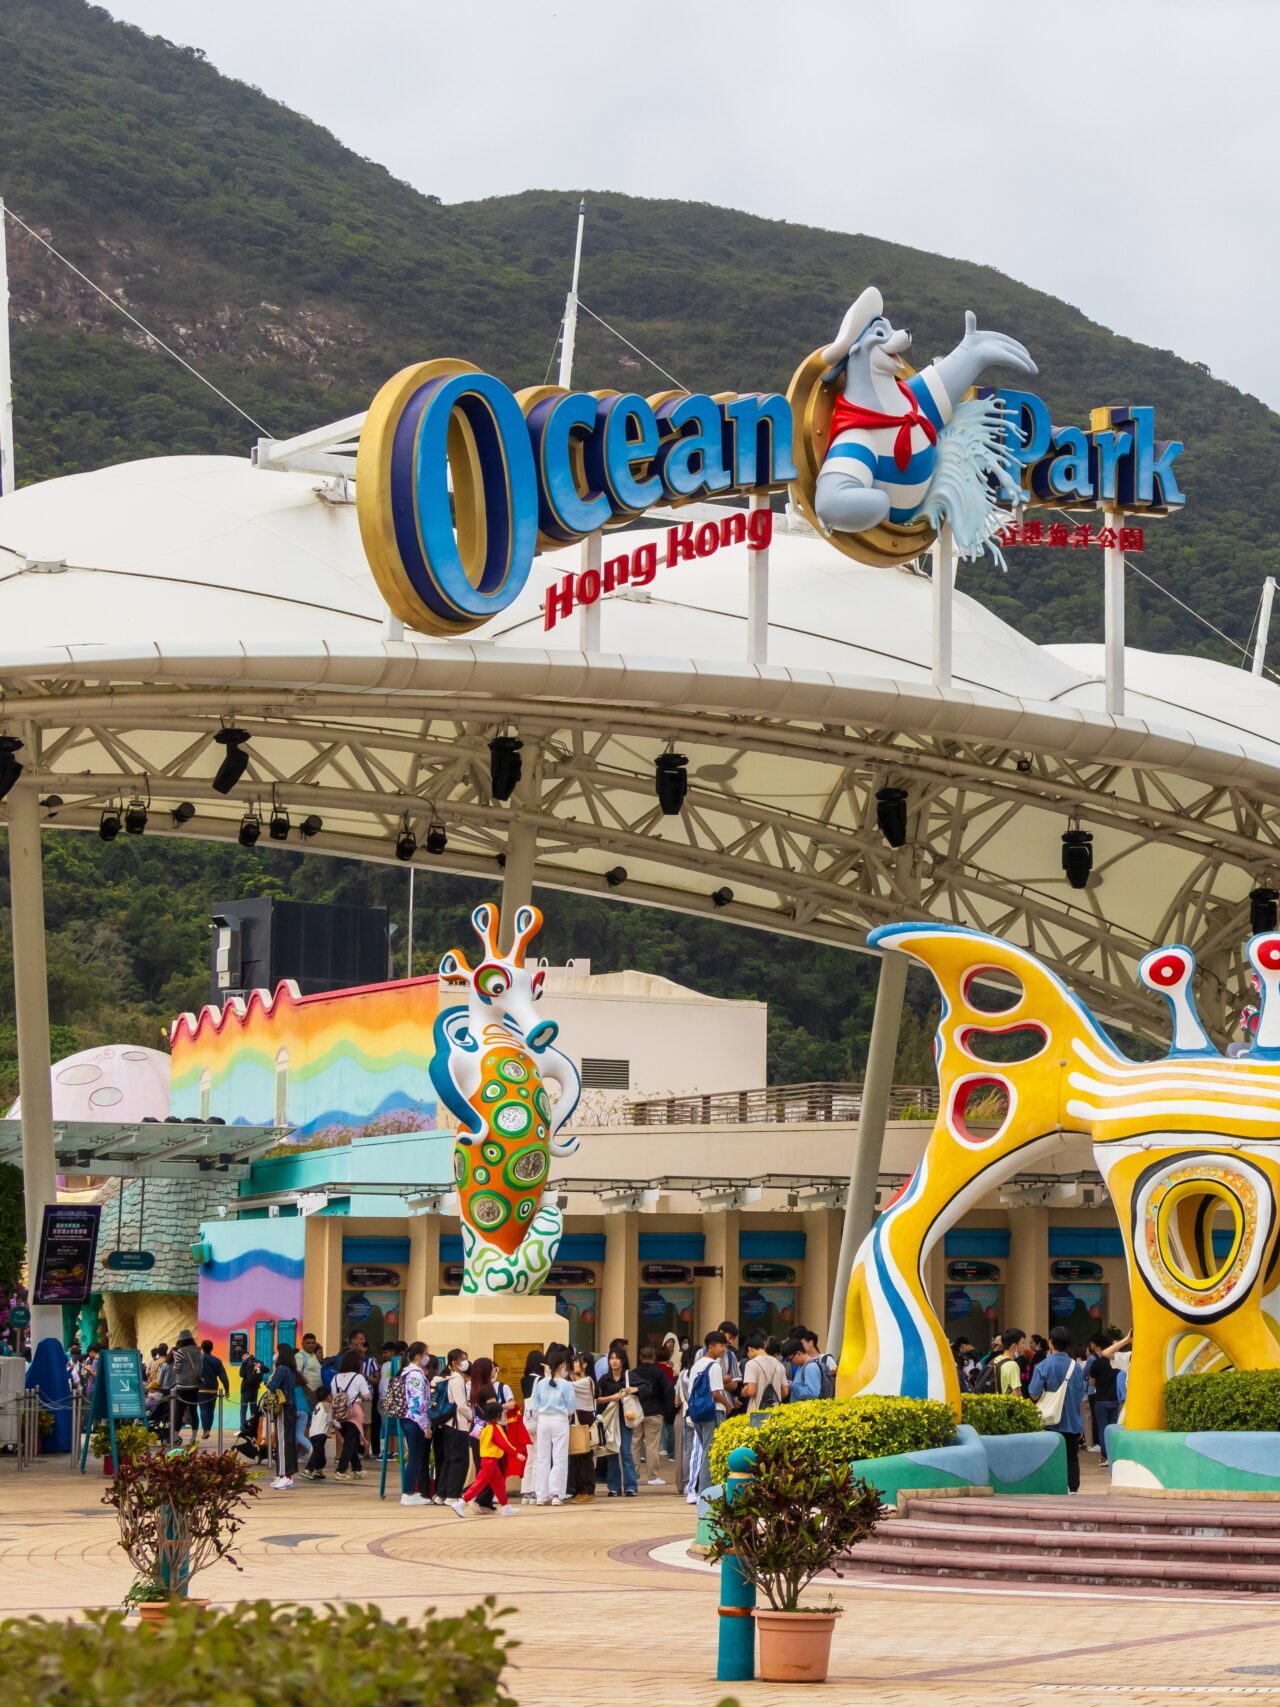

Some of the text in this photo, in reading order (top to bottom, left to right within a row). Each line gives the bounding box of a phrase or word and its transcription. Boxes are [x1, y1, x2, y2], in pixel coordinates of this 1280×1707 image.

[392, 367, 1188, 620] Ocean Park
[997, 519, 1146, 553] 香港海洋公園
[543, 507, 774, 632] Hong Kong
